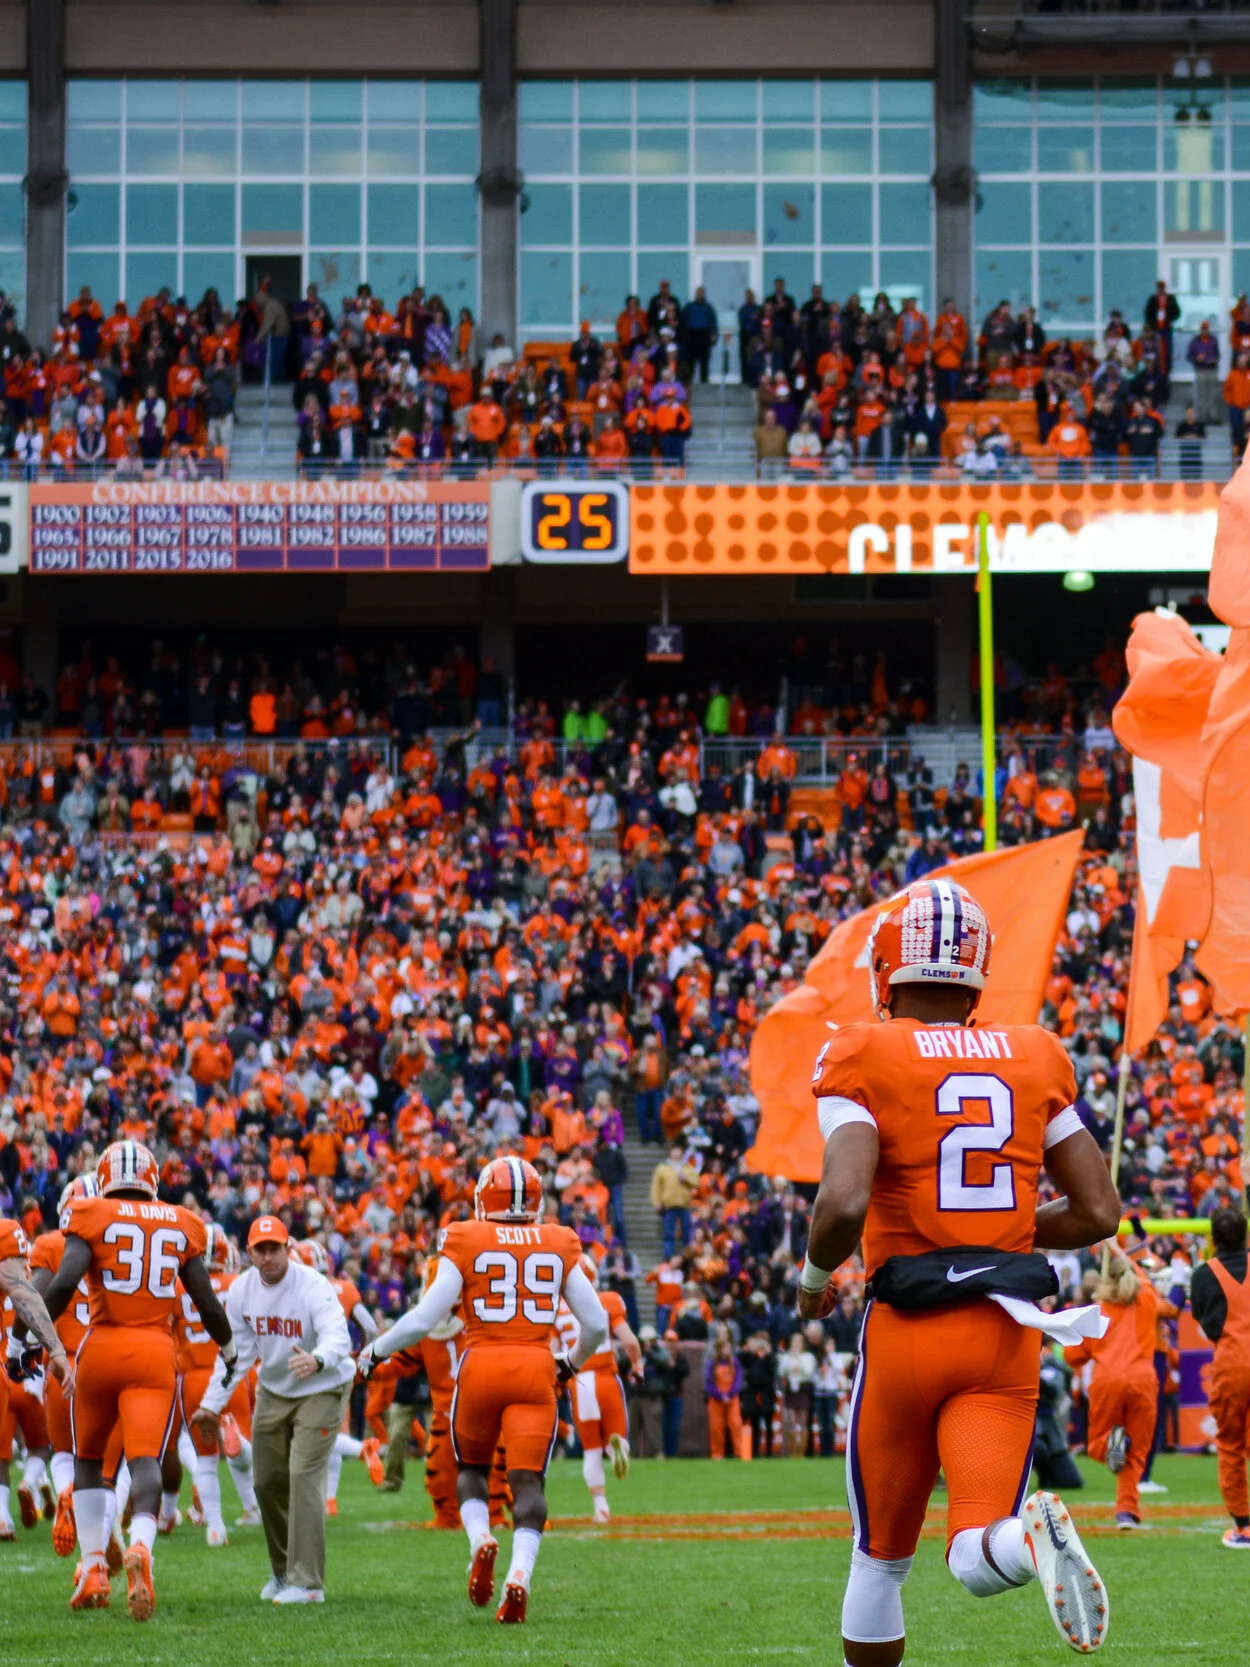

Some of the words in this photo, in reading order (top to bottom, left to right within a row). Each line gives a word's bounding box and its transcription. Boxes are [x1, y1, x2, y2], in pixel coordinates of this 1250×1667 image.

[91, 481, 262, 503] CONFERENCE
[270, 481, 428, 503] CHAMPIONS
[34, 505, 80, 525] 1900
[85, 505, 131, 525] 1902
[238, 504, 284, 524] 1940
[289, 504, 335, 524] 1948
[340, 503, 386, 523] 1956
[390, 503, 437, 523] 1958
[442, 503, 488, 523] 1959
[538, 493, 612, 549] 25
[85, 527, 131, 547] 1966
[136, 527, 181, 547] 1967
[186, 527, 232, 547] 1978
[238, 526, 284, 546] 1981
[289, 526, 335, 546] 1982
[340, 526, 386, 546] 1986
[390, 526, 437, 546] 1987
[36, 550, 78, 569] 1991
[85, 550, 129, 569] 2011
[135, 550, 181, 569] 2015
[186, 550, 232, 569] 2016
[952, 945, 960, 956] 2
[913, 1030, 1013, 1059] BRYANT
[936, 1072, 1017, 1212] 2
[141, 1204, 178, 1223] DAVIS
[259, 1220, 272, 1233] C
[495, 1226, 543, 1245] SCOTT
[101, 1222, 188, 1299] 36
[472, 1250, 564, 1325] 39
[243, 1314, 303, 1339] EMSON
